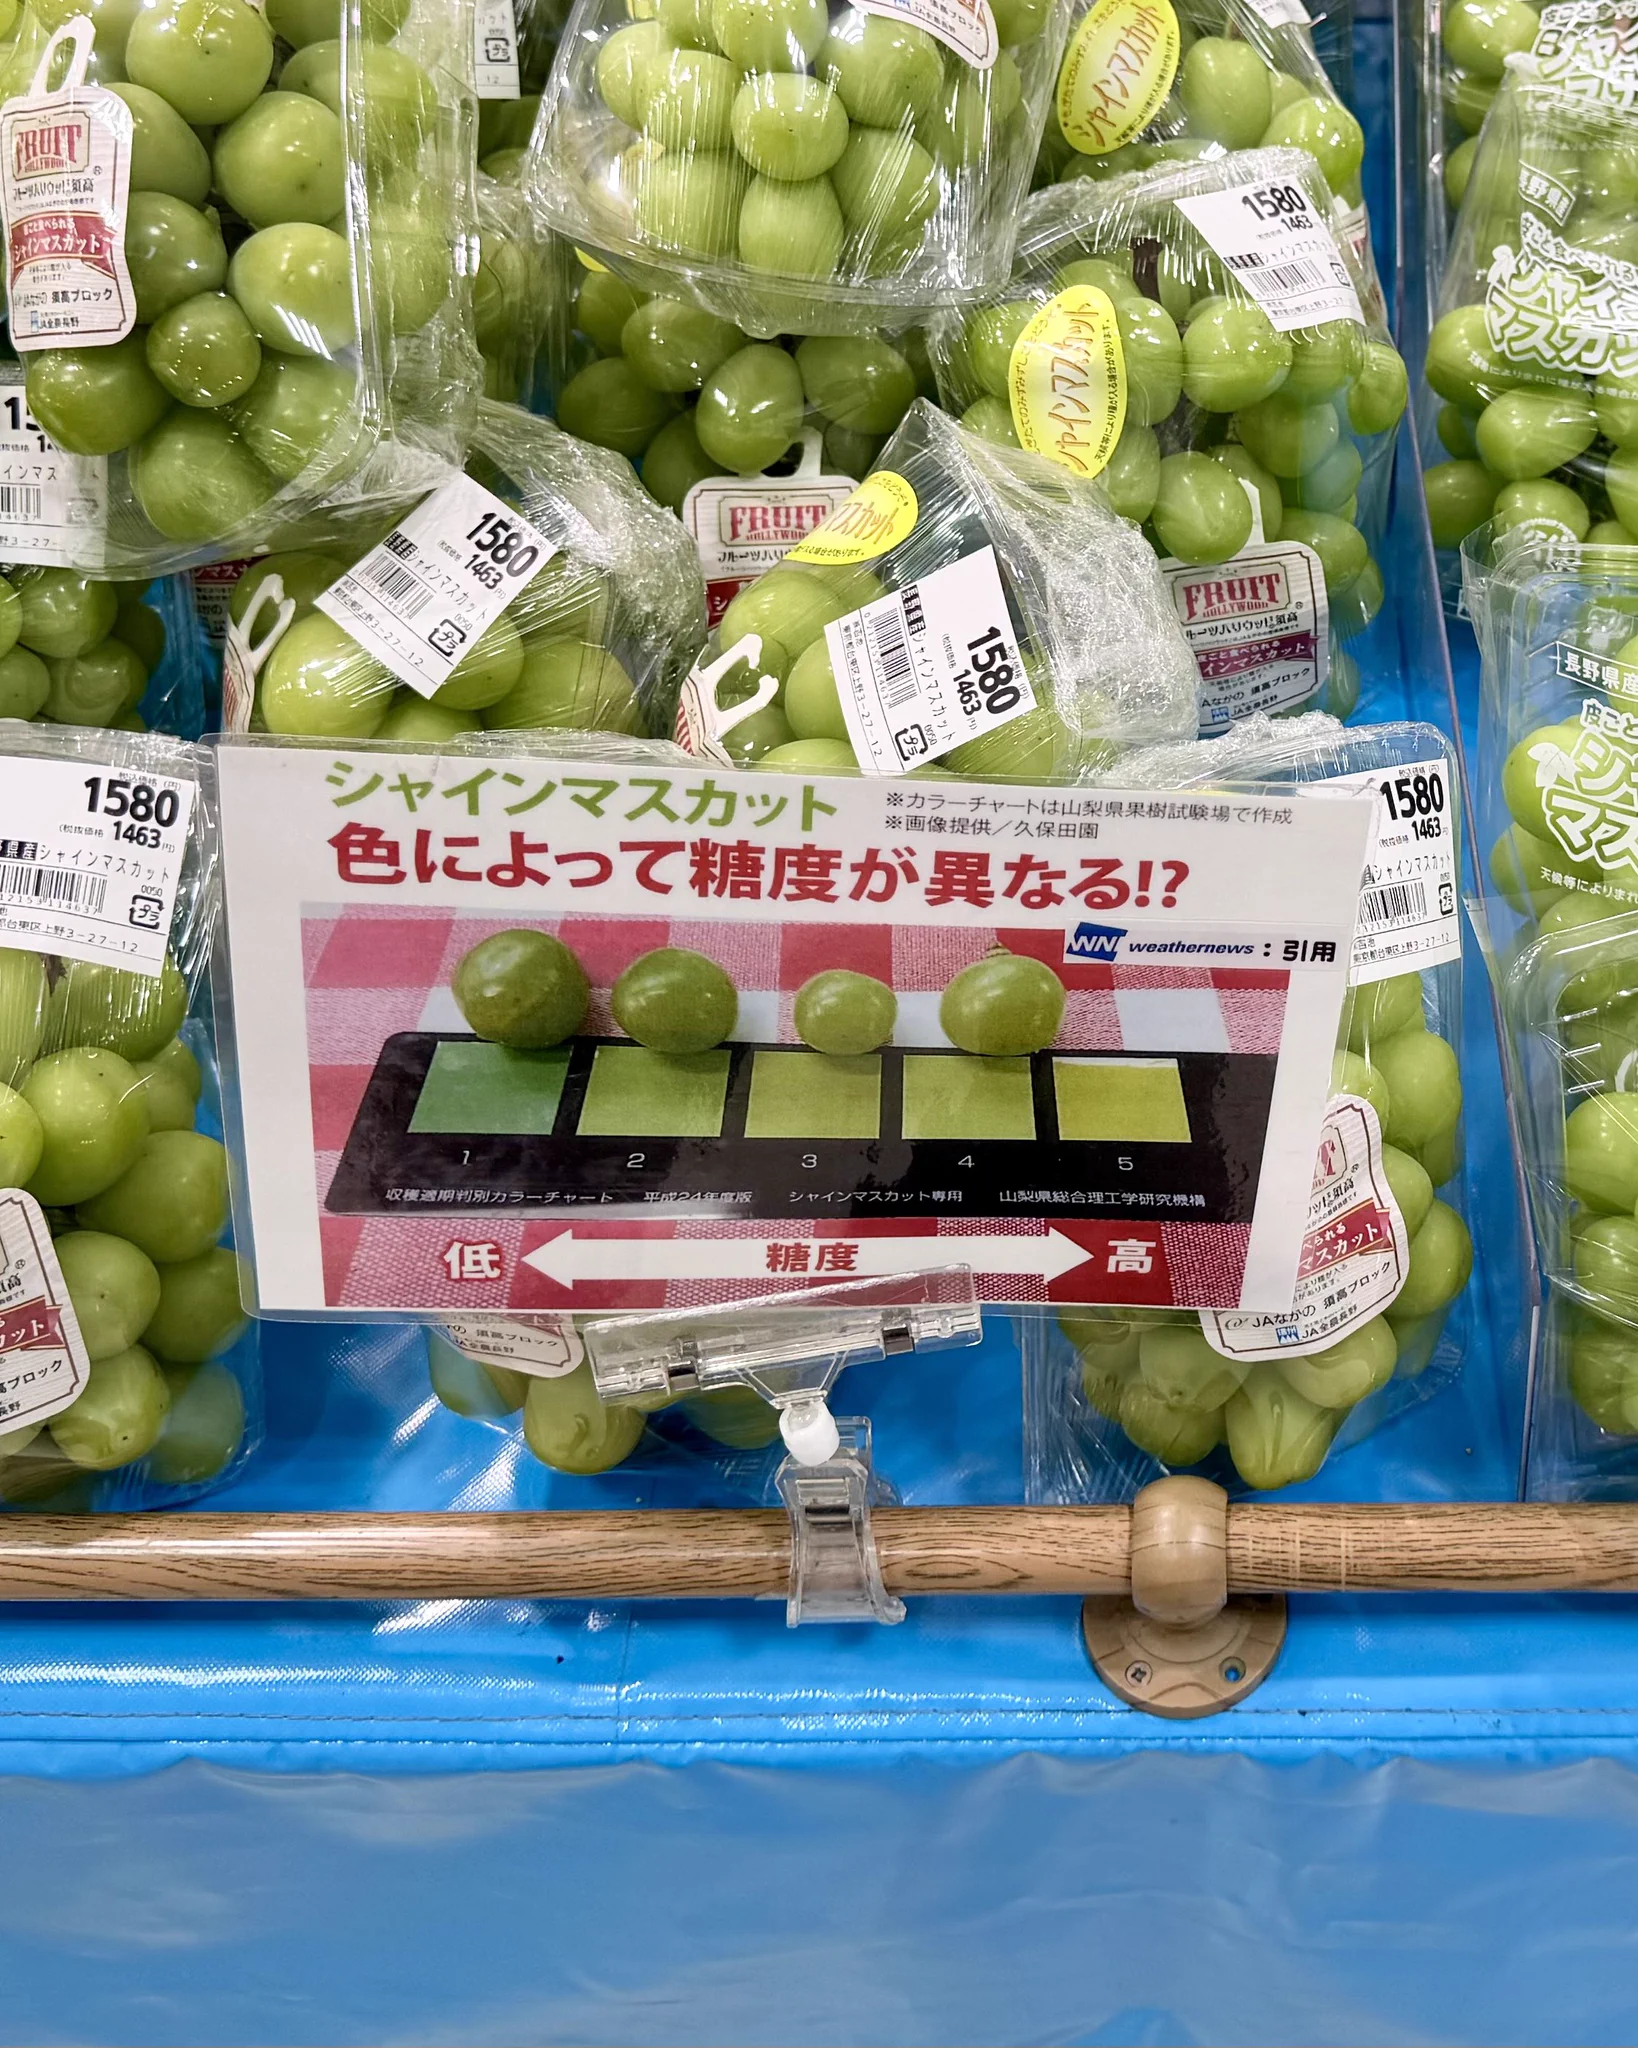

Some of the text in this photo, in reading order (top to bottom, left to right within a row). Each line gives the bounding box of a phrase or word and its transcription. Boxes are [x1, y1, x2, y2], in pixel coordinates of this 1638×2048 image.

[1072, 2, 1165, 147] シャインマスカット
[1242, 185, 1307, 221] 1580
[1281, 214, 1314, 233] 1463
[13, 234, 101, 261] シャインマスカット
[729, 505, 827, 542] FRUIT
[466, 512, 540, 578] 1580
[464, 553, 504, 590] 1463
[1183, 573, 1280, 621] FRUIT
[967, 625, 1021, 715] 1580
[1203, 643, 1305, 676] インマスカット
[953, 668, 982, 717] 1463
[924, 723, 938, 746] 0050
[84, 776, 180, 828] 1580
[325, 761, 837, 832] シャインマスカット
[886, 791, 1292, 825] ※カラーチャートは山梨県果樹試験場で作成
[1380, 774, 1444, 821] 1580
[113, 820, 161, 849] 1463
[1412, 817, 1441, 841] 1463
[39, 844, 170, 884] シャインマスカット
[327, 821, 1189, 910] 色によって糖度が異なる!?
[1129, 940, 1254, 957] weathernews
[461, 1151, 471, 1167] 1
[626, 1152, 646, 1168] 2
[800, 1154, 818, 1169] 3
[957, 1155, 975, 1169] 4
[1117, 1157, 1135, 1171] 5
[643, 1191, 753, 1204] 平成24年度版
[789, 1190, 963, 1203] シャインマスカット専用
[999, 1190, 1207, 1208] 山梨県総合理工学研究機構
[443, 1241, 502, 1280] 低
[765, 1242, 860, 1273] 糖度
[1107, 1238, 1158, 1275] 高
[1300, 1223, 1378, 1271] マスカット
[1252, 1304, 1316, 1329] JAながの
[1323, 1261, 1391, 1309] 須高ブロック
[1302, 1304, 1358, 1340] JA全農長野
